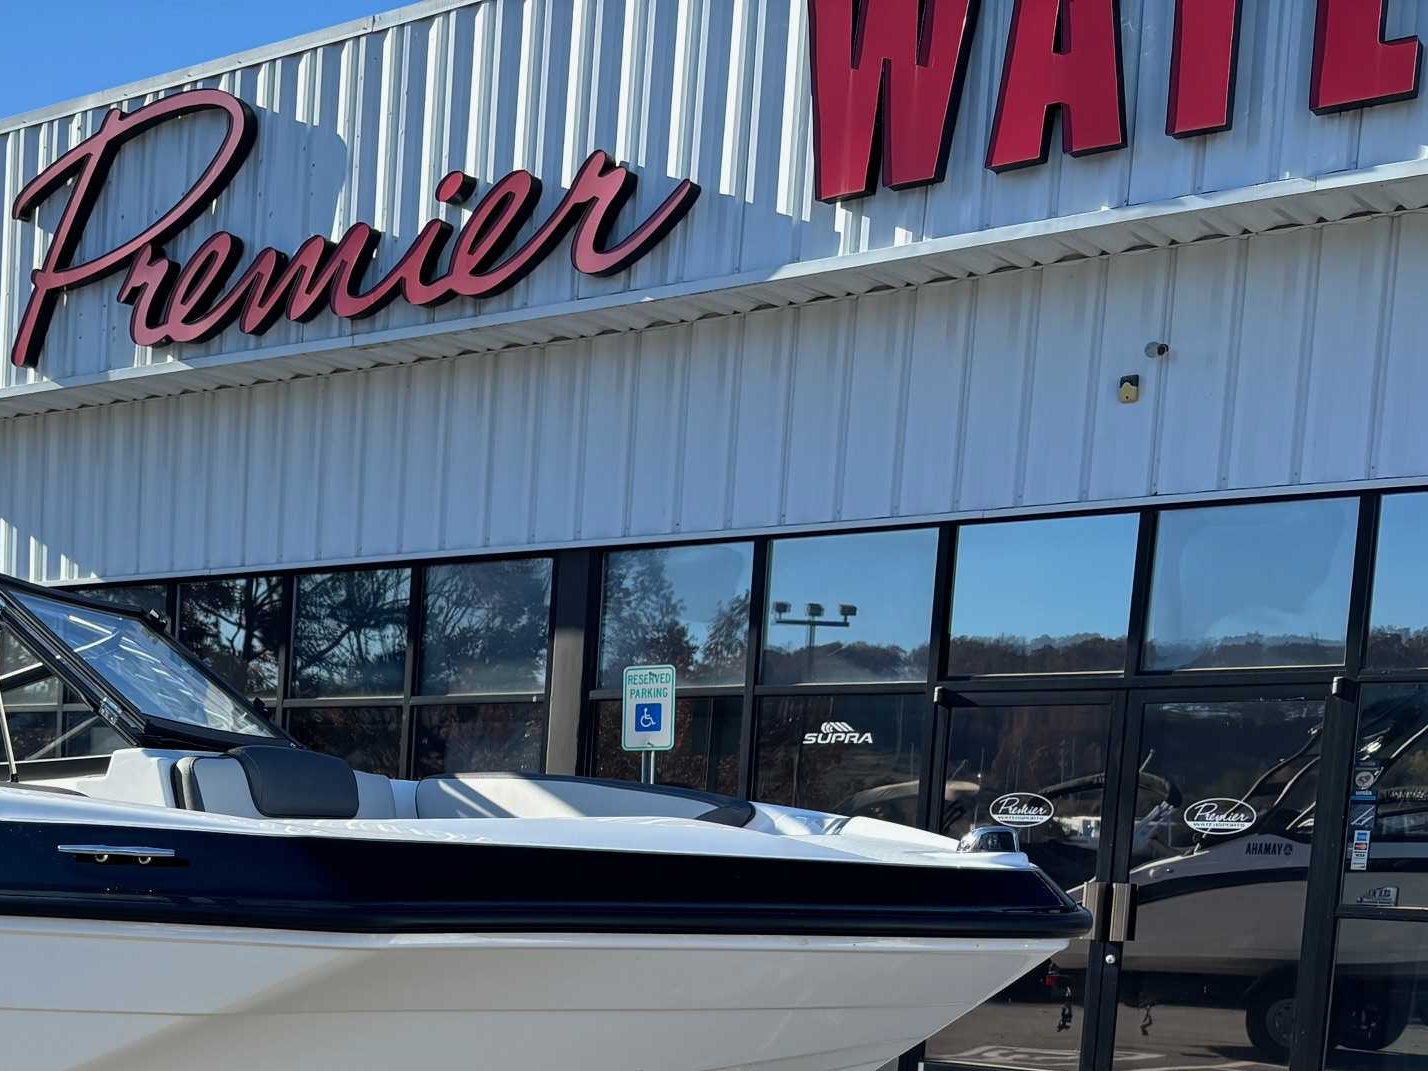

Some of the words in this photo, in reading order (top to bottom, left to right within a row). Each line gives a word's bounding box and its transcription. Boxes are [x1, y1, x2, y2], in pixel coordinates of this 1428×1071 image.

[12, 89, 702, 368] Premier
[627, 672, 671, 685] RESERVED
[630, 687, 668, 699] PARKING
[802, 732, 873, 744] SUPRA
[998, 797, 1047, 814] Premier
[1193, 802, 1249, 822] Premier
